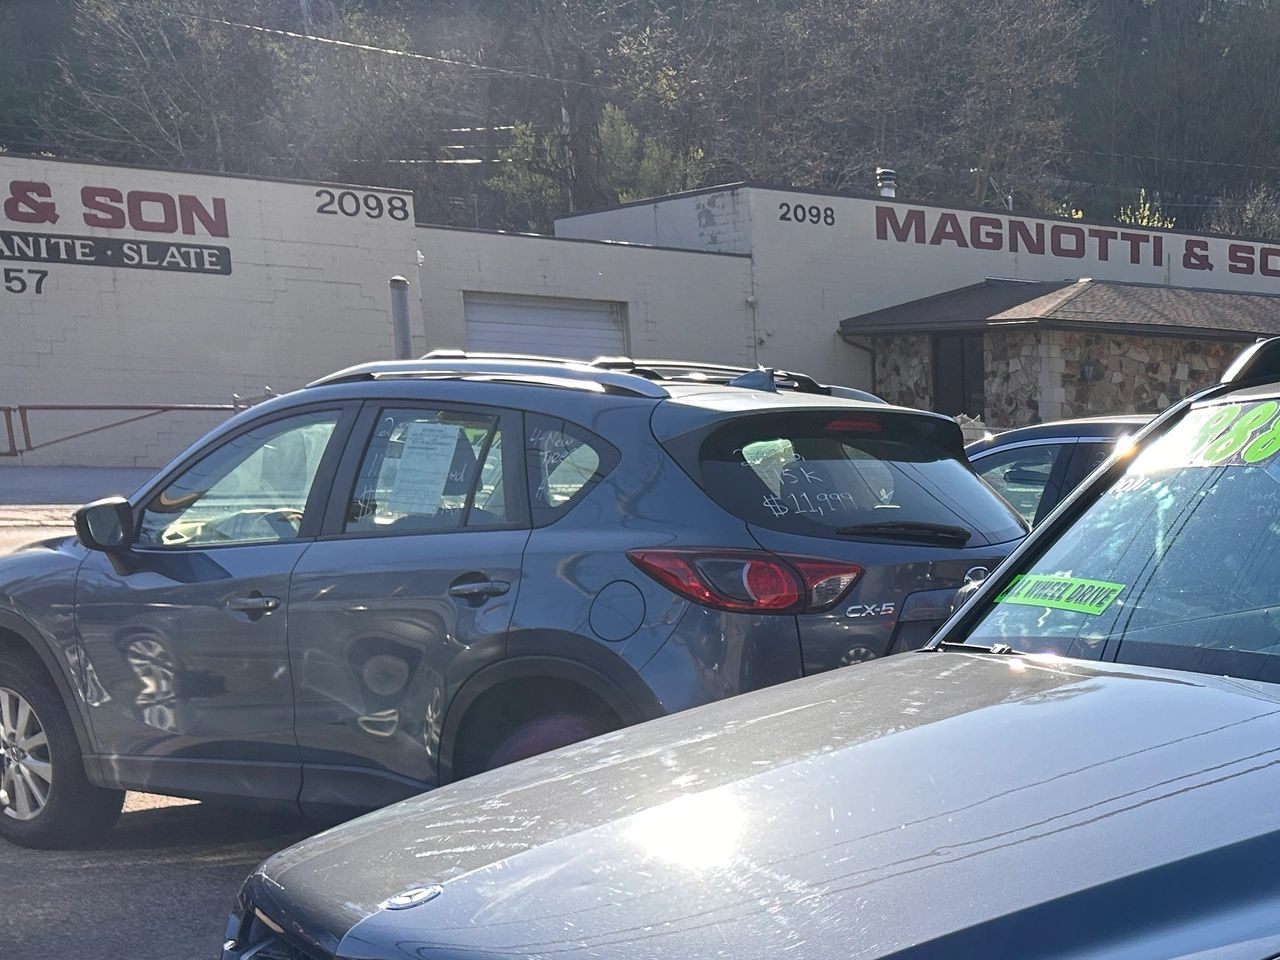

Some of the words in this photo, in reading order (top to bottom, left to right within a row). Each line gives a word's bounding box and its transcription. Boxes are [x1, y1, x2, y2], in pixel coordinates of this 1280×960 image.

[4, 180, 60, 224] &
[81, 186, 229, 238] SON
[315, 189, 410, 221] 2098
[779, 203, 835, 226] 2098
[875, 205, 1163, 266] MAGNOTTI
[1182, 239, 1213, 271] &
[122, 243, 221, 270] SLATE
[4, 267, 48, 294] 57
[1065, 583, 1118, 608] DRIVE
[846, 602, 895, 618] CX-5
